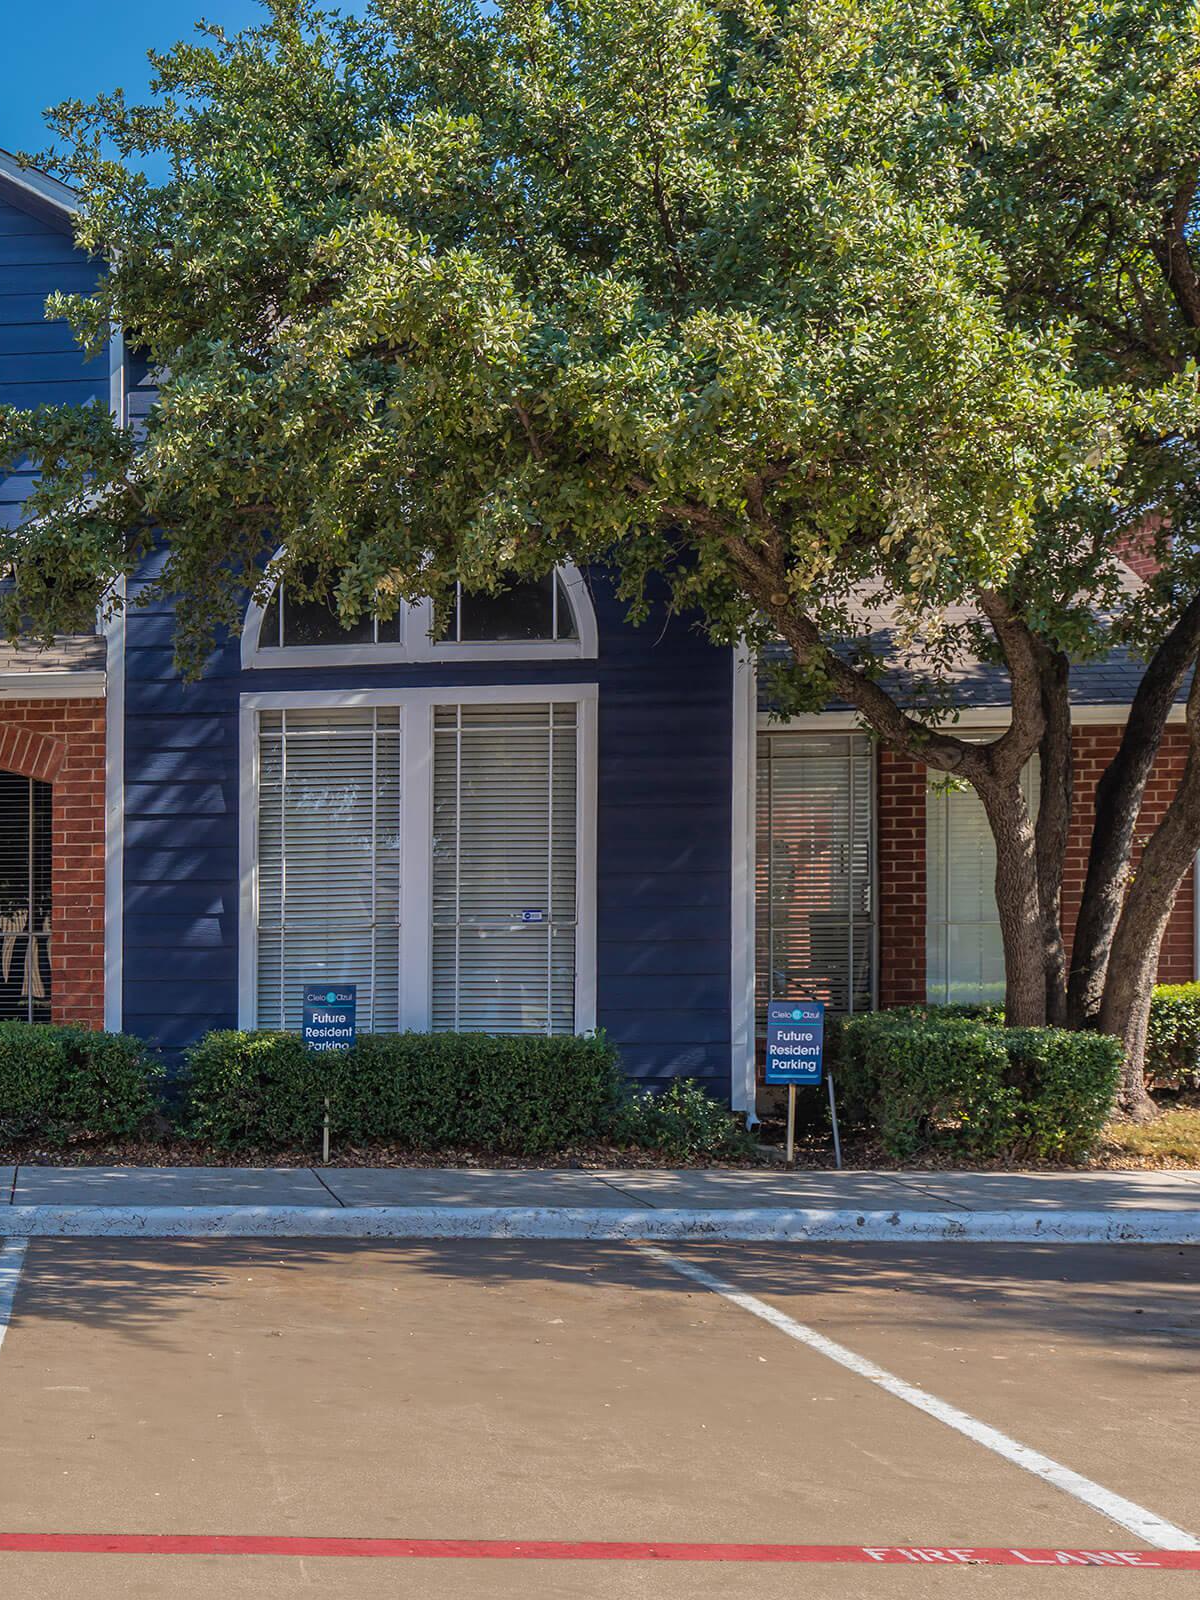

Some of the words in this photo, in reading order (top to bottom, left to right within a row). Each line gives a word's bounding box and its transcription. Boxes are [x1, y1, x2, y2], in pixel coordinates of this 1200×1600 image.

[307, 993, 326, 1002] Cielo
[312, 1013, 346, 1024] Future
[771, 1010, 792, 1019] Cielo
[305, 1027, 353, 1038] Resident
[777, 1030, 813, 1041] Future
[769, 1045, 820, 1056] Resident
[771, 1059, 817, 1073] Parking
[862, 1548, 988, 1562] FIRE
[1010, 1549, 1161, 1566] LANE
